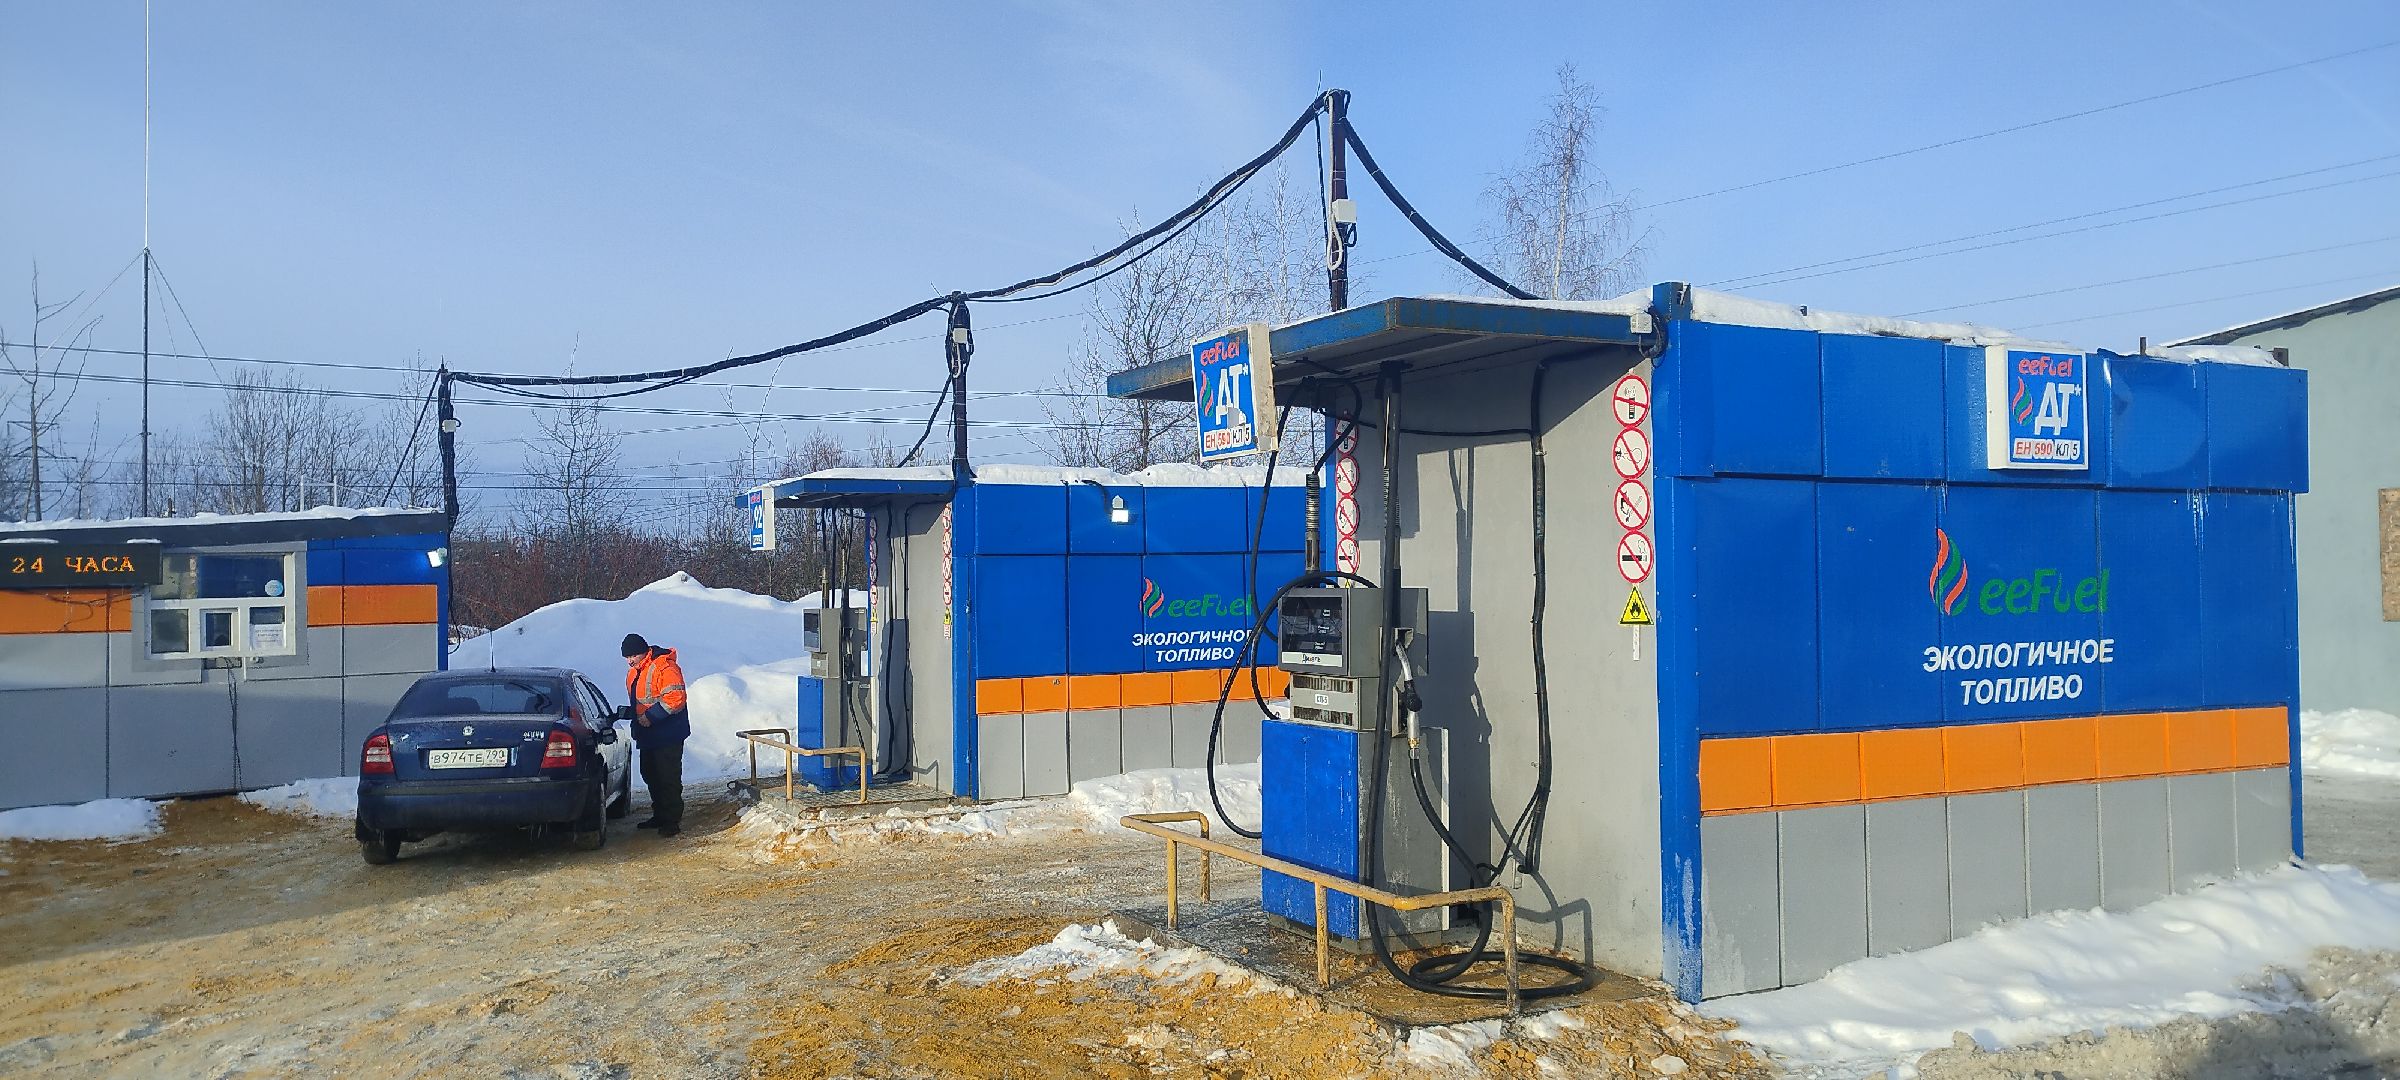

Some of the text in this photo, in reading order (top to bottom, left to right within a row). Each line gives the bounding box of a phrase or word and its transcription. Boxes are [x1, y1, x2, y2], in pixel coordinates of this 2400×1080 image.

[2018, 356, 2073, 377] eeFuel
[2016, 441, 2078, 457] ЕН 590 КЛ 5
[11, 555, 136, 574] 24 ЧАСА
[1978, 568, 2111, 616] eeFuel
[1156, 647, 1235, 663] ТОПЛИВО
[1922, 638, 2115, 673] ЭКОЛОГИЧНОЕ
[1960, 674, 2083, 706] ТОПЛИВО
